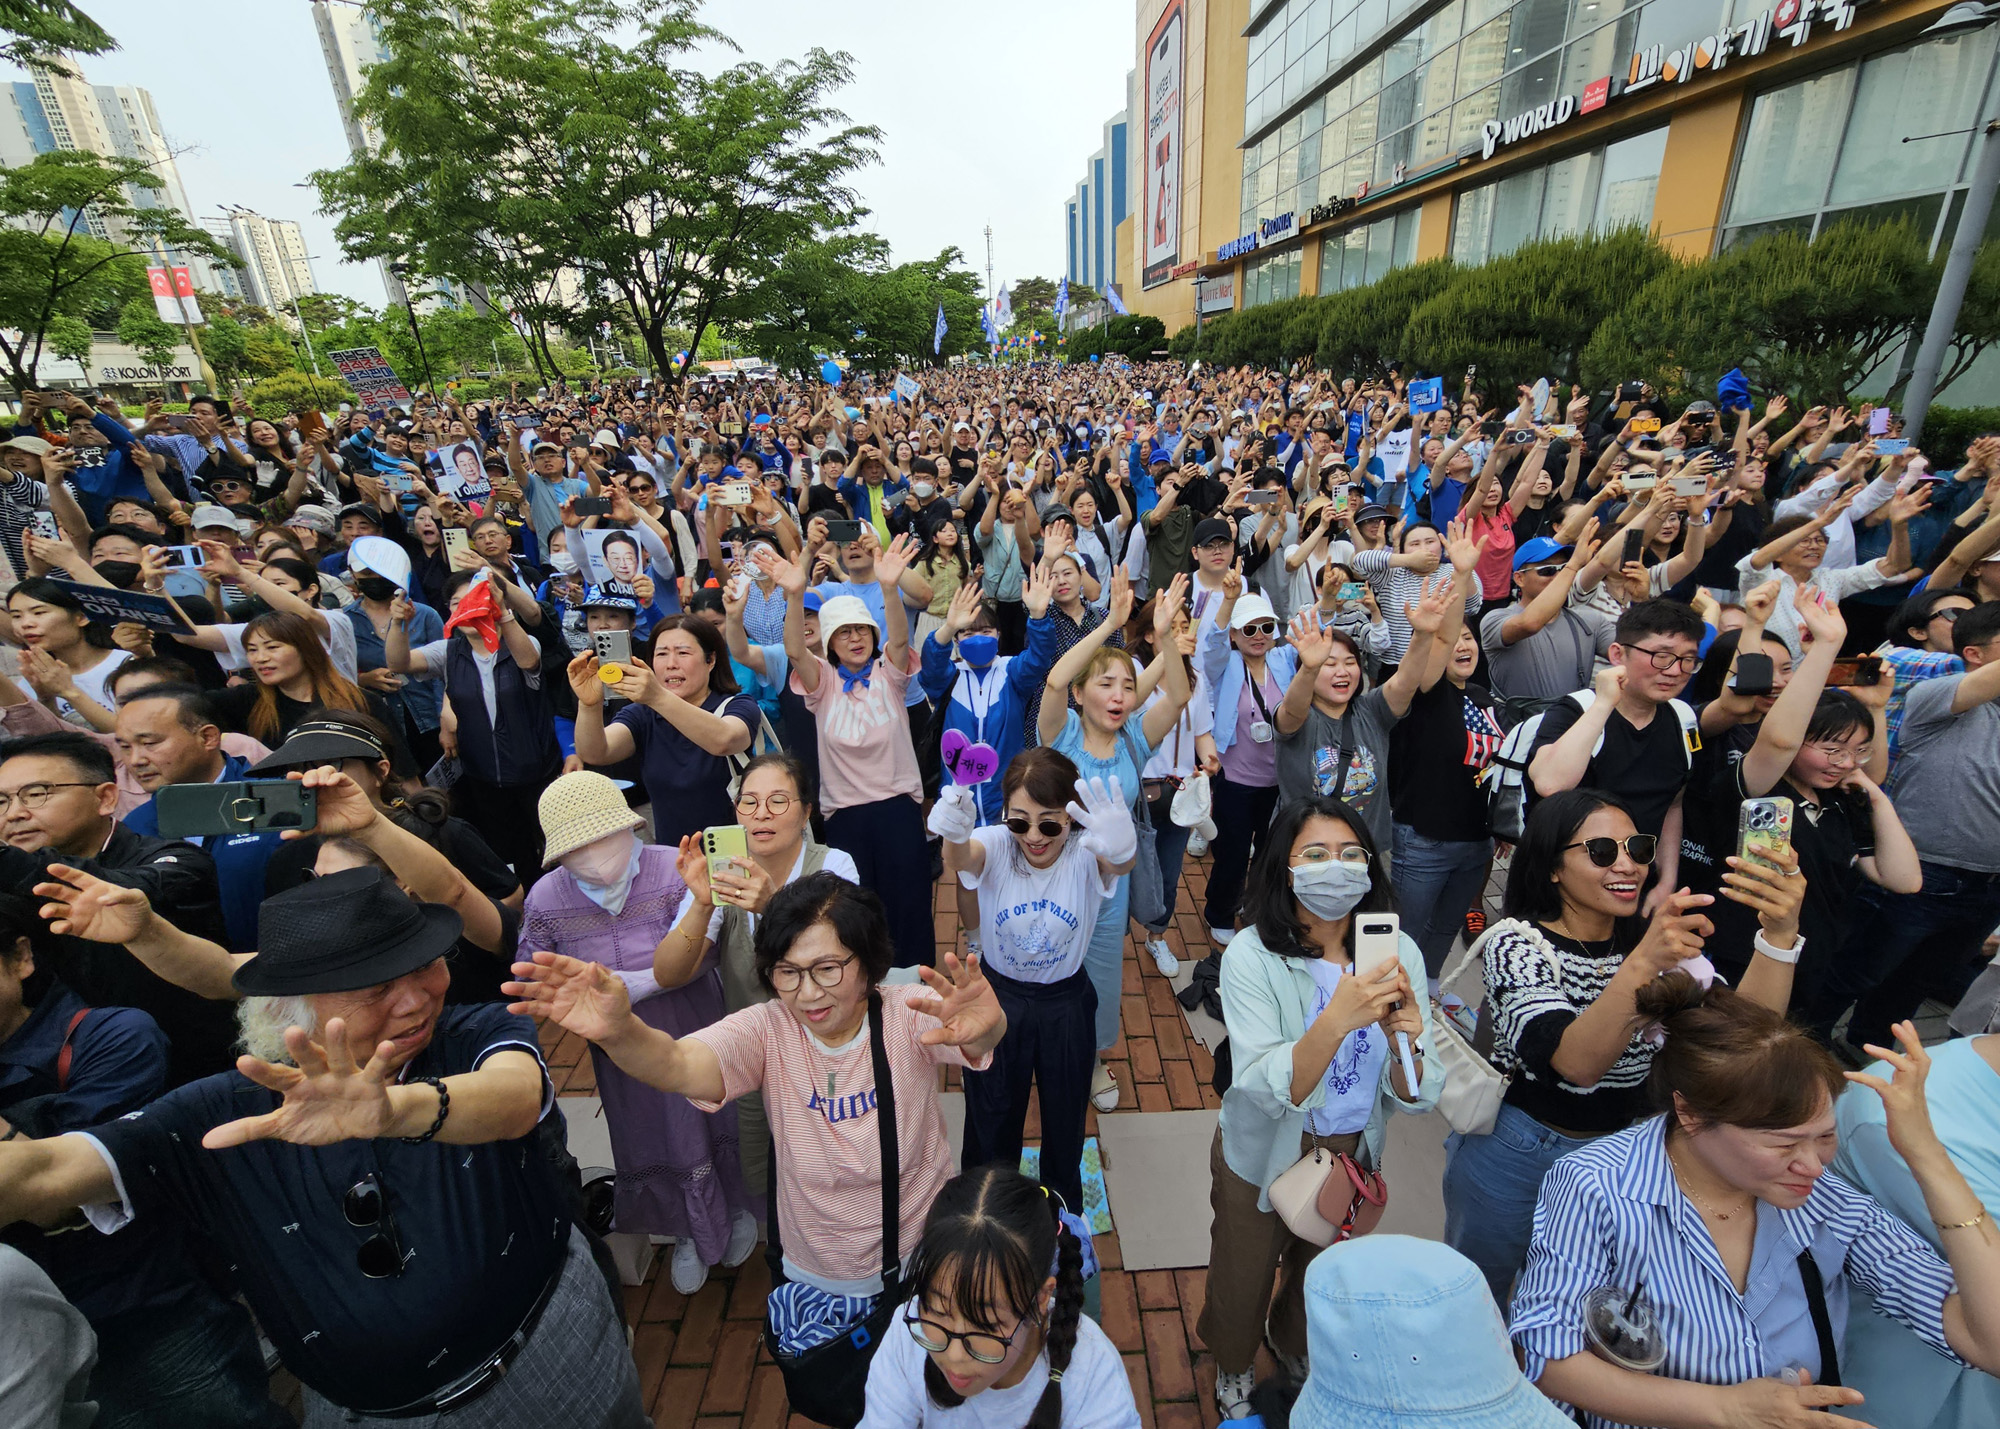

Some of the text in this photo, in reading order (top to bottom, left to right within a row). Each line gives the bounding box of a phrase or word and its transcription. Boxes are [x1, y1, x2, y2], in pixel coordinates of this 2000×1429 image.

[1504, 95, 1576, 145] WORLD
[1203, 281, 1232, 302] LOTTE Mart
[118, 366, 192, 380] KOLON SPORT
[609, 581, 636, 596] 이재
[1681, 839, 1705, 854] ONAL
[1013, 903, 1028, 916] OF
[1050, 901, 1079, 931] VALLEY
